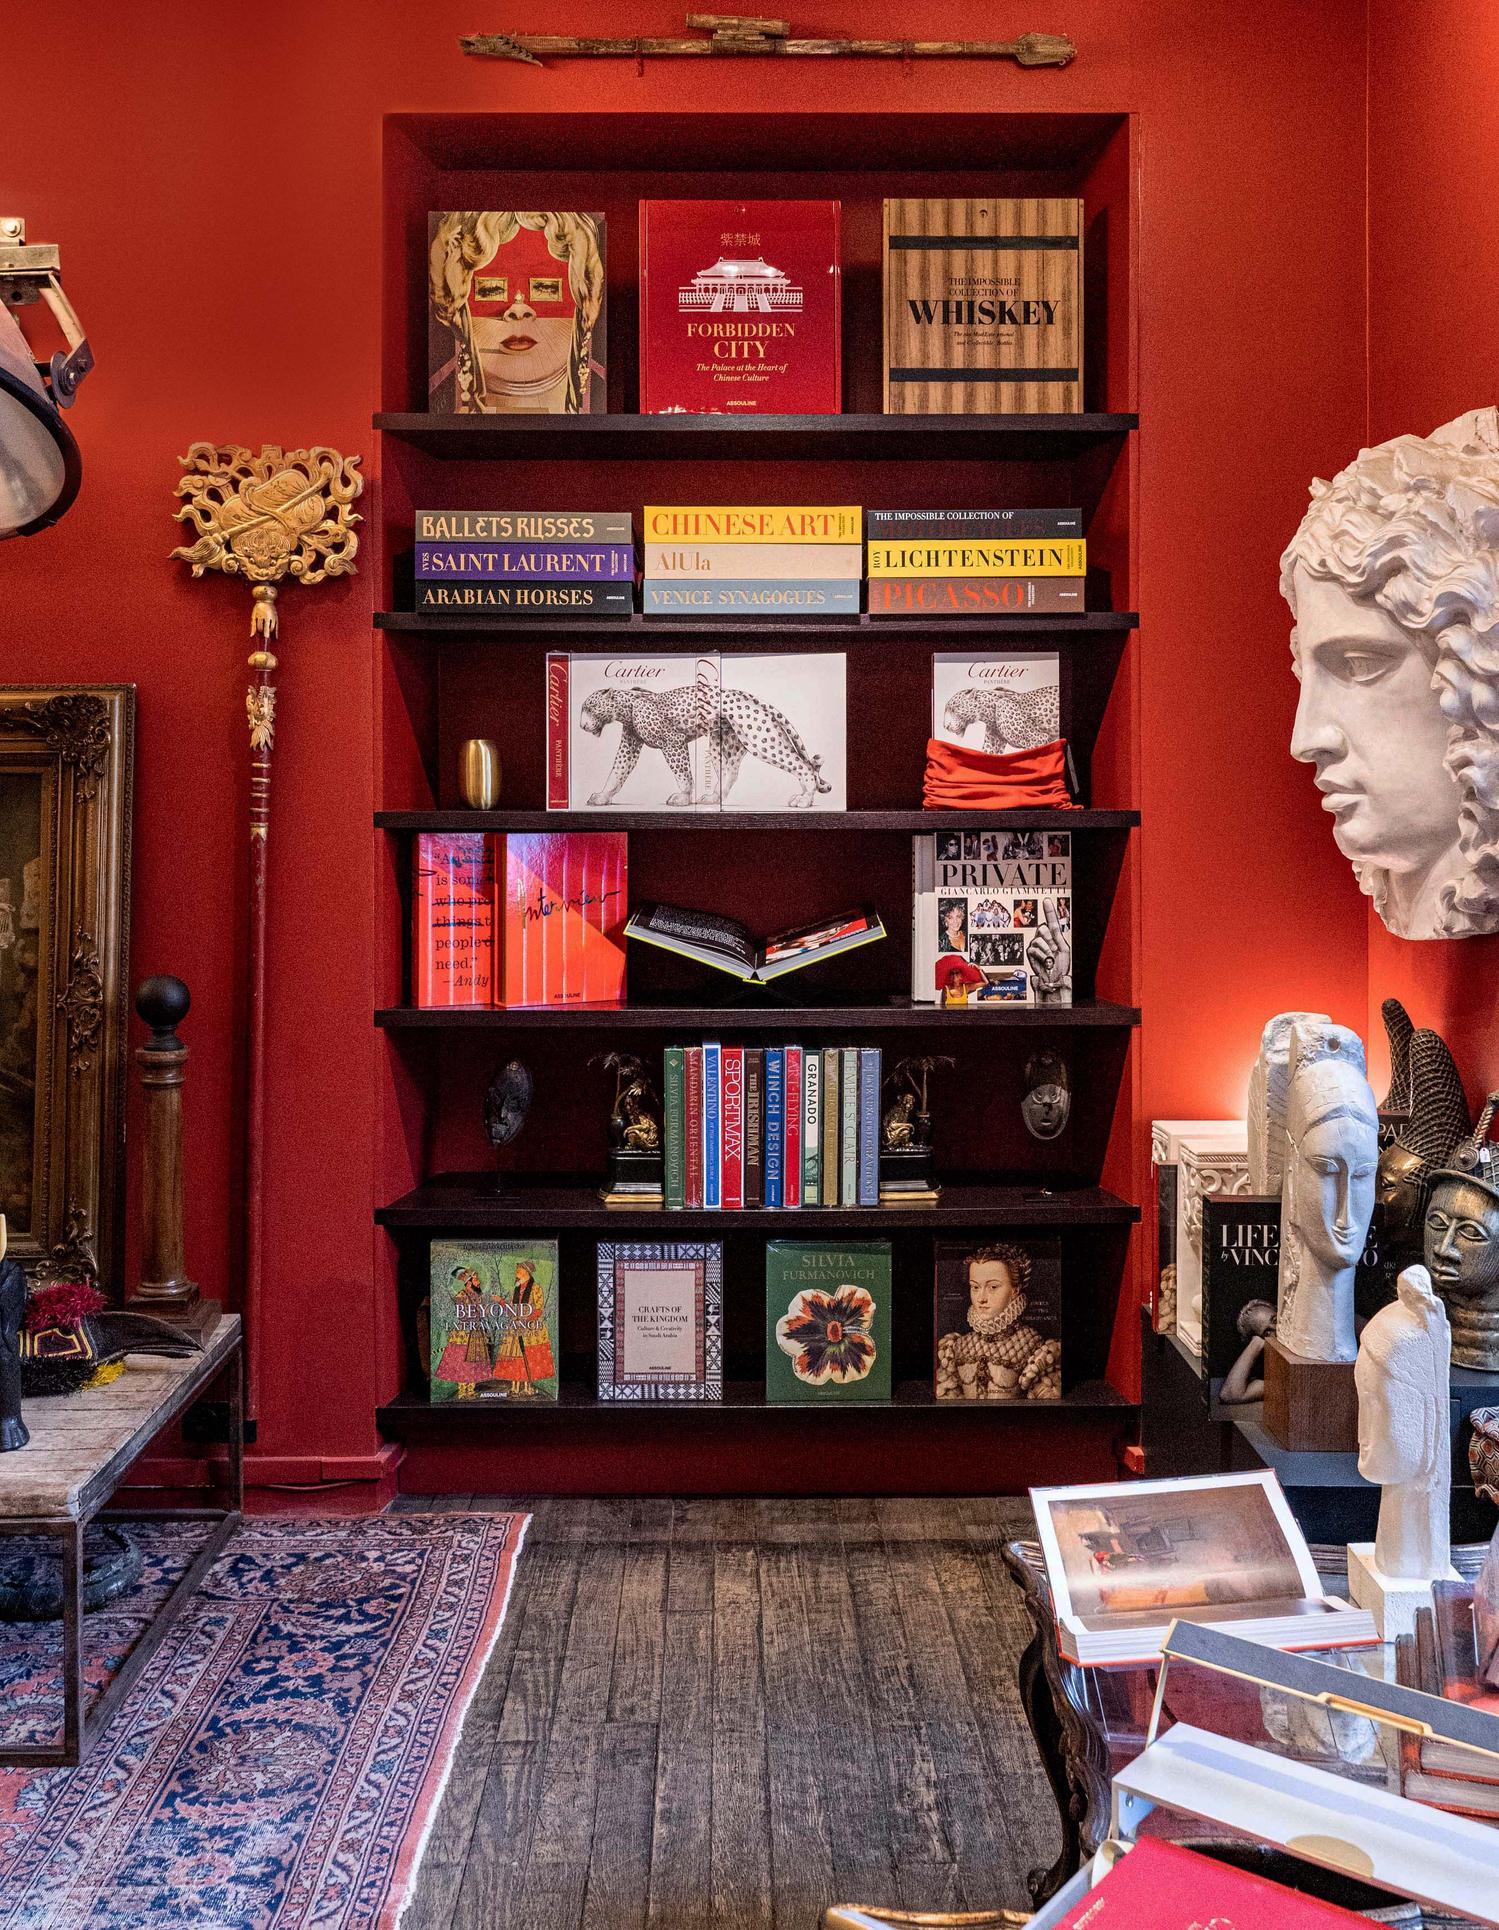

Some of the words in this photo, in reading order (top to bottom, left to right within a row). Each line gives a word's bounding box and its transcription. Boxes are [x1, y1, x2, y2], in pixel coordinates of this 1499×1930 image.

[720, 233, 761, 246] 紫禁城
[949, 277, 967, 286] THE
[968, 277, 1020, 286] IMPOSSIBLE
[949, 288, 1004, 296] COLLECTION
[1006, 288, 1018, 296] OF
[906, 299, 1061, 325] WHISKEY
[687, 323, 795, 337] FORBIDDEN
[714, 340, 769, 359] CITY
[713, 374, 741, 382] Chinese
[742, 374, 770, 382] Culture
[779, 363, 789, 374] of
[652, 513, 775, 536] CHINESE
[780, 513, 835, 536] ART
[875, 512, 893, 521] THE
[894, 512, 945, 521] IMPOSSIBLE
[947, 511, 1001, 520] COLLECTION
[1002, 511, 1014, 520] OF
[422, 516, 513, 540] BALLETS
[422, 552, 430, 571] YVES
[432, 553, 498, 572] SAINT
[502, 553, 605, 572] LAURENT
[654, 551, 711, 571] AlUla
[873, 551, 881, 569] ROY
[884, 548, 1064, 568] LICHTENSTEIN
[422, 589, 510, 605] ARABIAN
[516, 589, 594, 605] HORSES
[650, 590, 713, 605] VENICE
[718, 590, 826, 605] SYNAGOGUES
[882, 581, 1025, 609] PICASSO
[604, 660, 666, 678] Cartier
[967, 660, 1029, 679] Cartier
[549, 662, 568, 727] Cartier
[697, 659, 719, 737] Cartier
[436, 874, 448, 886] is
[940, 863, 1067, 887] PRIVATE
[940, 886, 1000, 895] GIANCARLO
[1002, 886, 1067, 895] GIAMMETTI
[435, 935, 482, 951] people
[669, 1074, 679, 1106] SILVIA
[689, 1056, 699, 1115] MANDARIN
[707, 1055, 717, 1119] VALENTINO
[749, 1072, 758, 1091] THE
[768, 1060, 780, 1114] WINCH
[844, 1058, 856, 1108] TEMPLE
[807, 1064, 817, 1125] GRANADO
[724, 1059, 741, 1161] SPORTMAX
[747, 1091, 759, 1166] IRISHMAN
[669, 1109, 679, 1188] FURMANOVICH
[689, 1119, 699, 1178] ORIENTAL
[768, 1121, 780, 1180] DESIGN
[844, 1126, 856, 1165] CLAIR
[802, 1254, 856, 1268] SILVIA
[1221, 1250, 1229, 1262] by
[783, 1270, 875, 1281] FURMANOVICH
[455, 1303, 533, 1318] BEYOND
[632, 1315, 649, 1323] THE
[650, 1315, 688, 1323] KINGDOM
[444, 1320, 543, 1331] EXTRAVAGANCE
